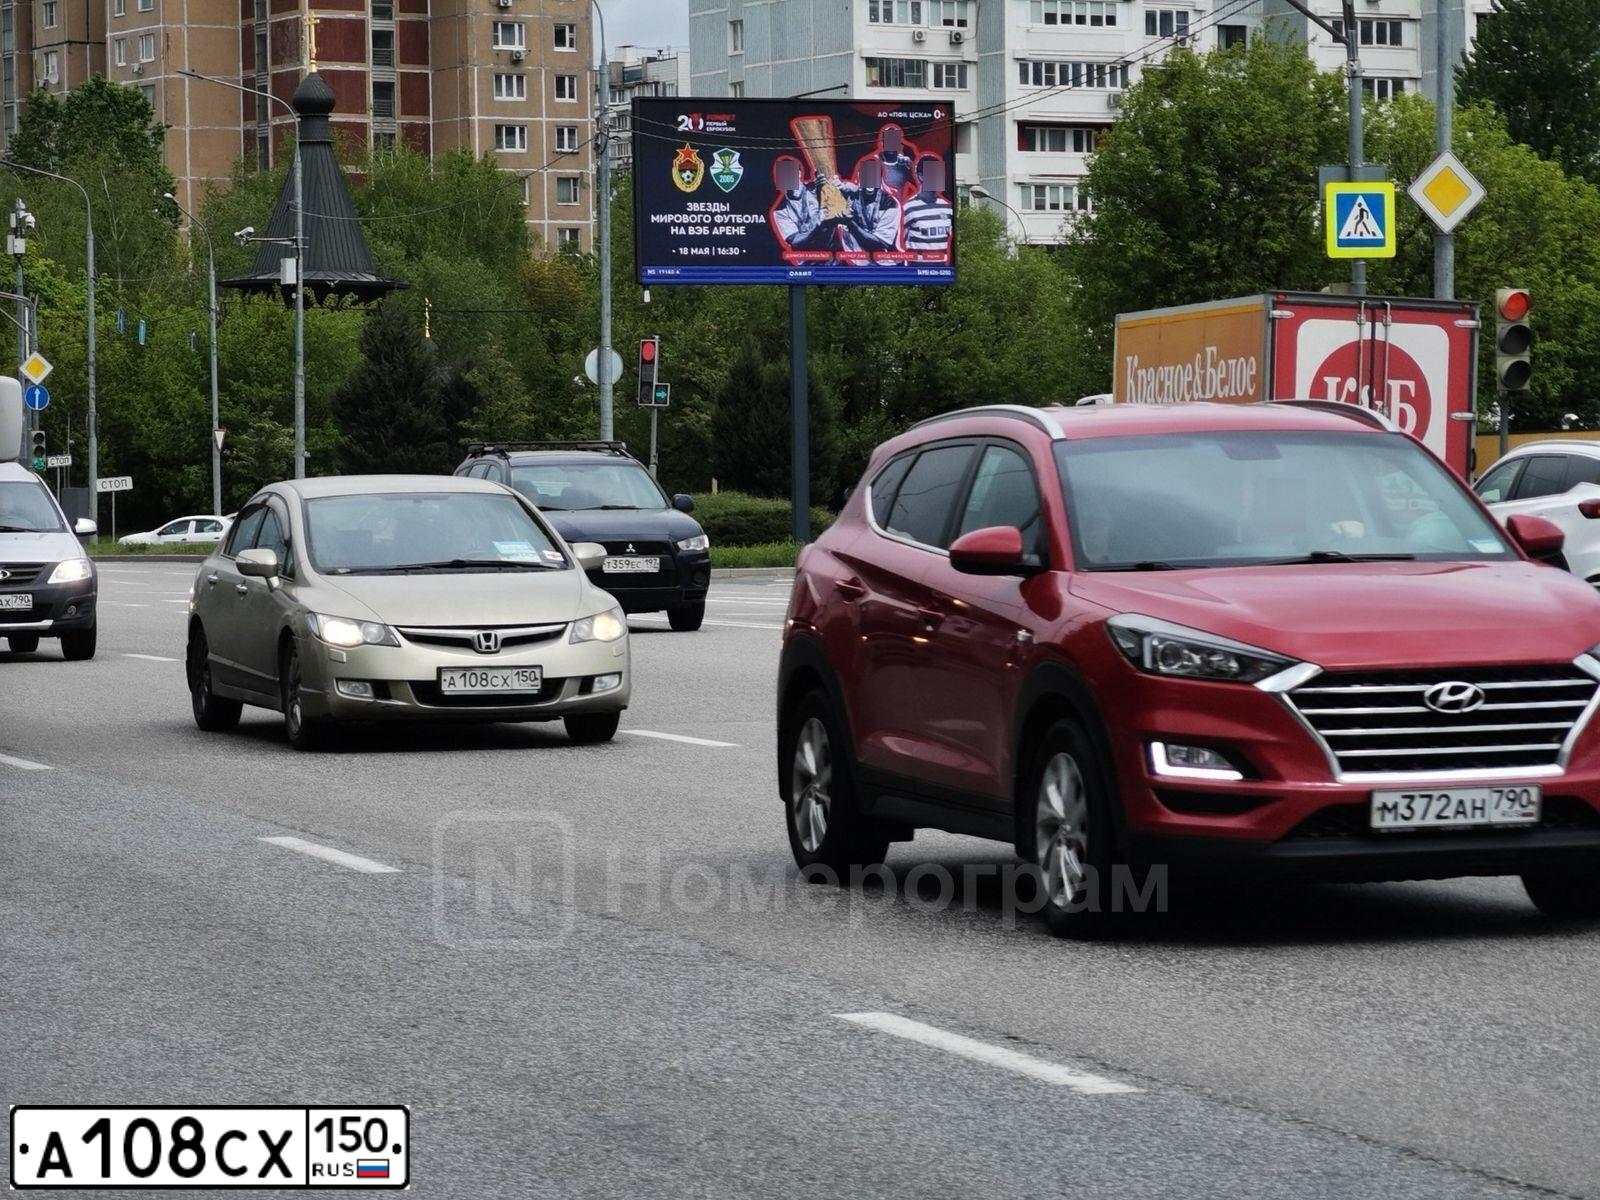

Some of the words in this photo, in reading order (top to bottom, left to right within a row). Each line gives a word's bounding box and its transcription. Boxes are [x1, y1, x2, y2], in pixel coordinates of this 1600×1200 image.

[719, 174, 735, 183] 2005
[686, 202, 730, 213] ЗВЕЗДЫ
[650, 214, 711, 223] МИРОВОГО
[714, 214, 766, 224] ФУТБОЛА
[670, 226, 686, 235] НА
[688, 226, 709, 235] ВЭБ
[712, 226, 746, 235] АРЕНЕ
[679, 247, 688, 255] 18
[690, 247, 709, 255] МАЯ
[717, 247, 740, 255] 16:30
[1126, 346, 1256, 404] Красное&Белое
[50, 456, 70, 465] СТОП
[101, 478, 128, 489] СТОП
[607, 559, 642, 569] Т359ЕС
[13, 595, 29, 603] 790
[447, 672, 510, 688] А108СХ
[514, 670, 537, 683] 150
[1380, 793, 1486, 822] М372АН
[1491, 788, 1532, 810] 790
